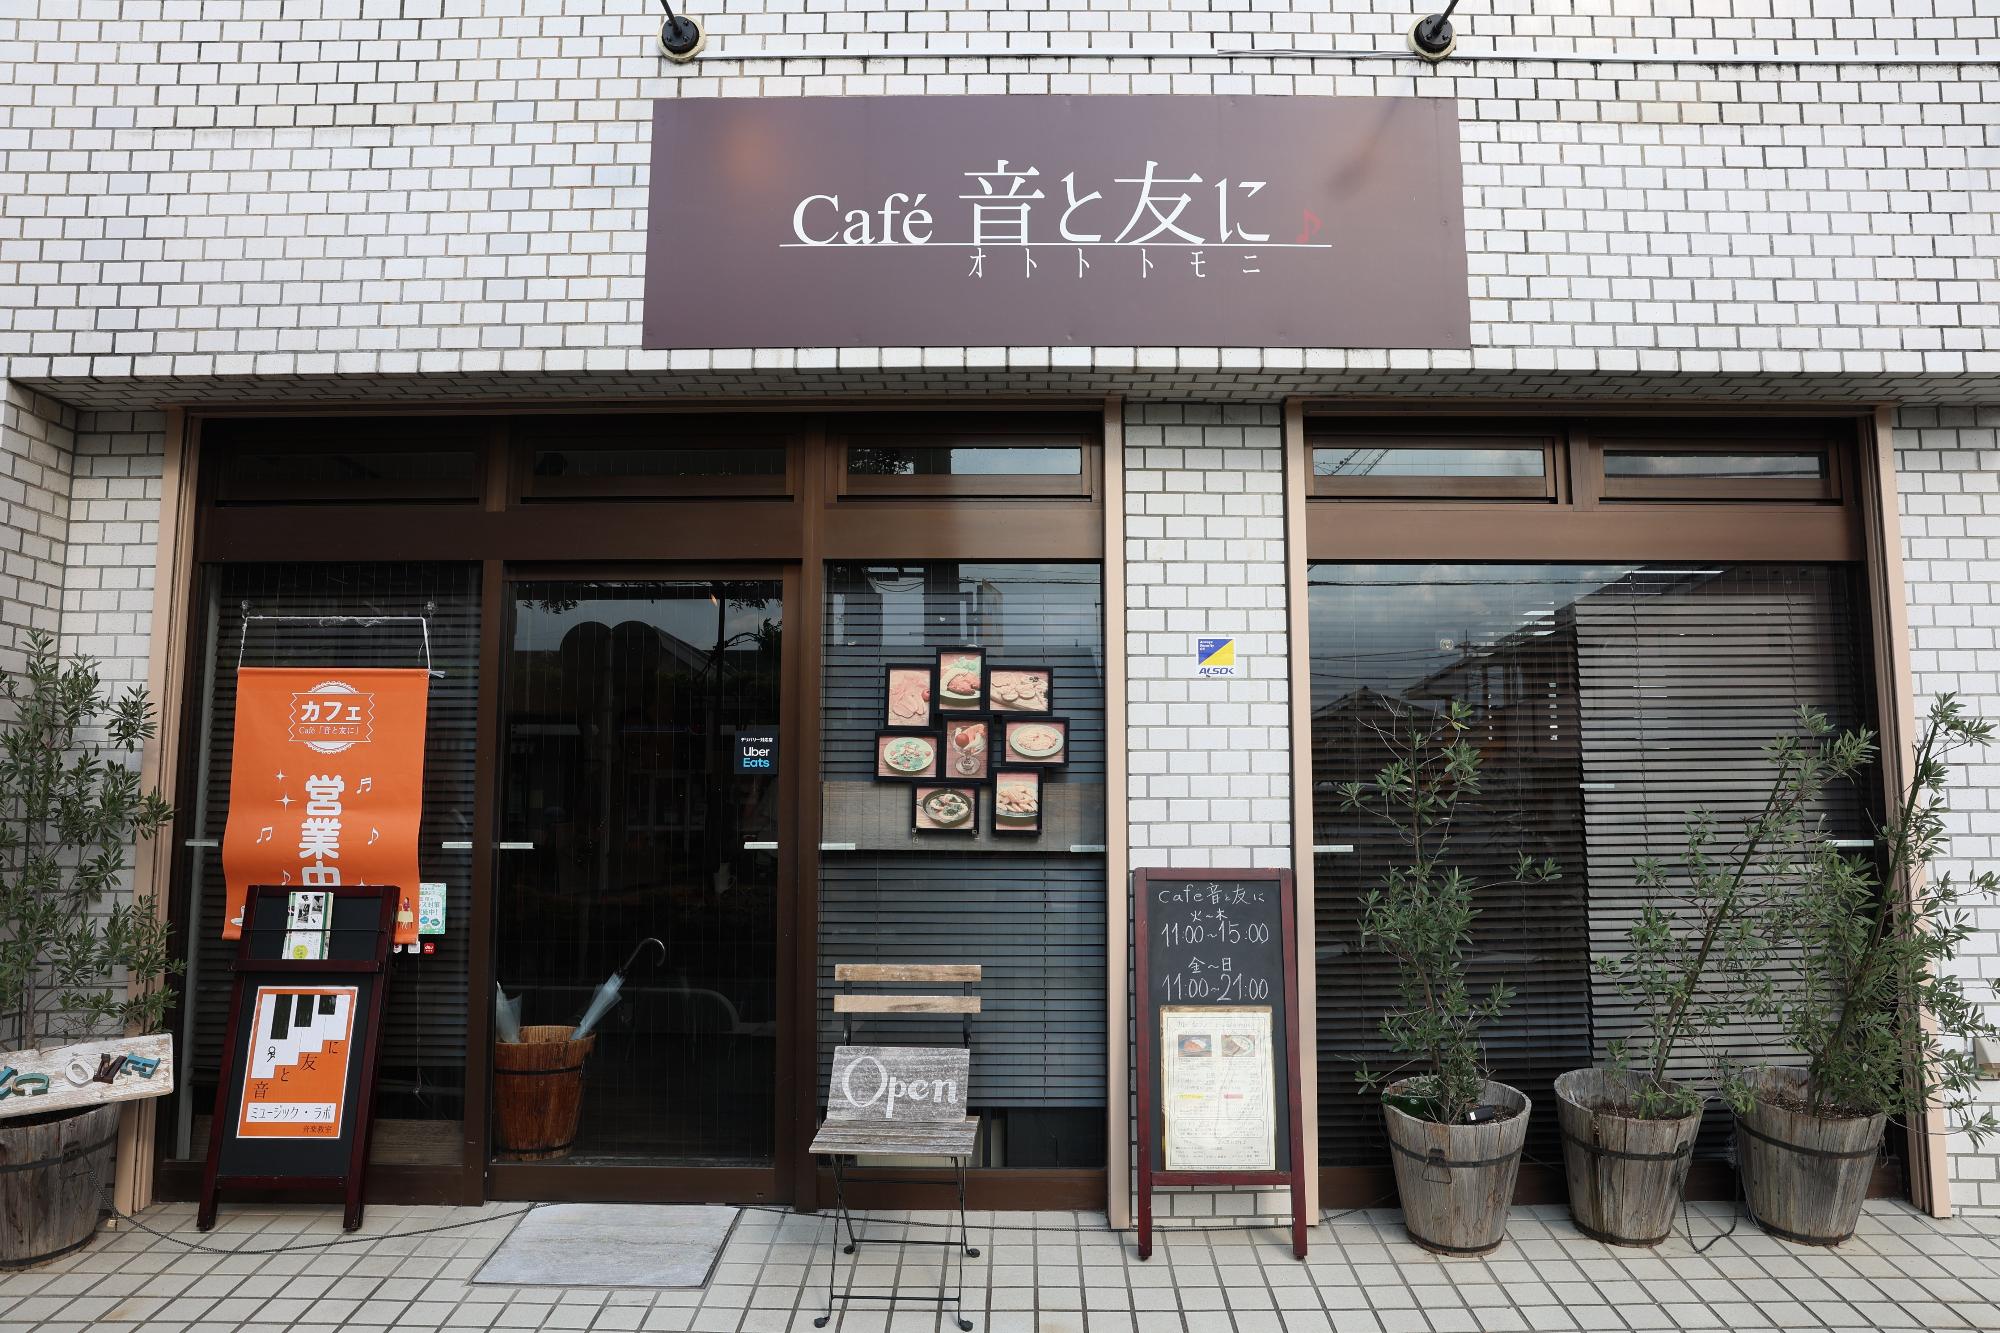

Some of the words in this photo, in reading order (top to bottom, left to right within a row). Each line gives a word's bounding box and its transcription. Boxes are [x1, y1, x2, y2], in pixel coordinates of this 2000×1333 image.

[793, 192, 933, 245] Café
[958, 160, 1270, 245] 音と友に
[968, 247, 1261, 279] オトトトモニ
[1199, 667, 1235, 675] ALSOK
[301, 700, 362, 722] カフェ
[743, 746, 770, 757] Uber
[743, 757, 770, 767] Eats
[842, 1056, 958, 1119] Open
